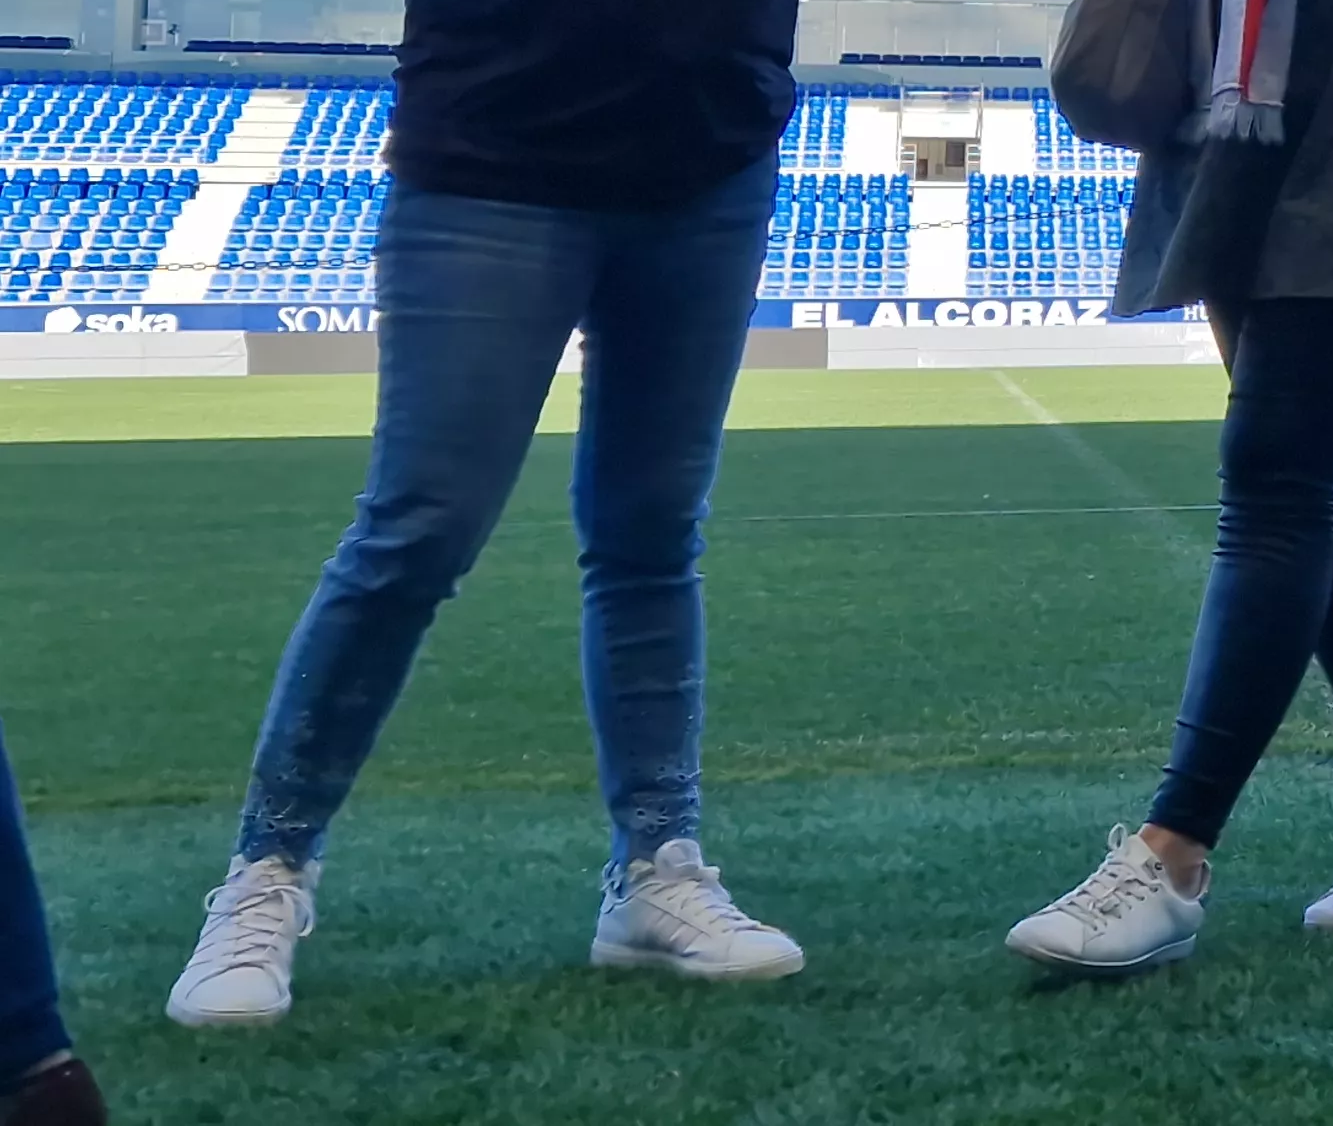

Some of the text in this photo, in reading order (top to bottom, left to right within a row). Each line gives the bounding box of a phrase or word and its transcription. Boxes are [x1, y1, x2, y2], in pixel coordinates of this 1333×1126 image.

[85, 306, 178, 333] soka
[791, 300, 1108, 328] EL ALCORAZ
